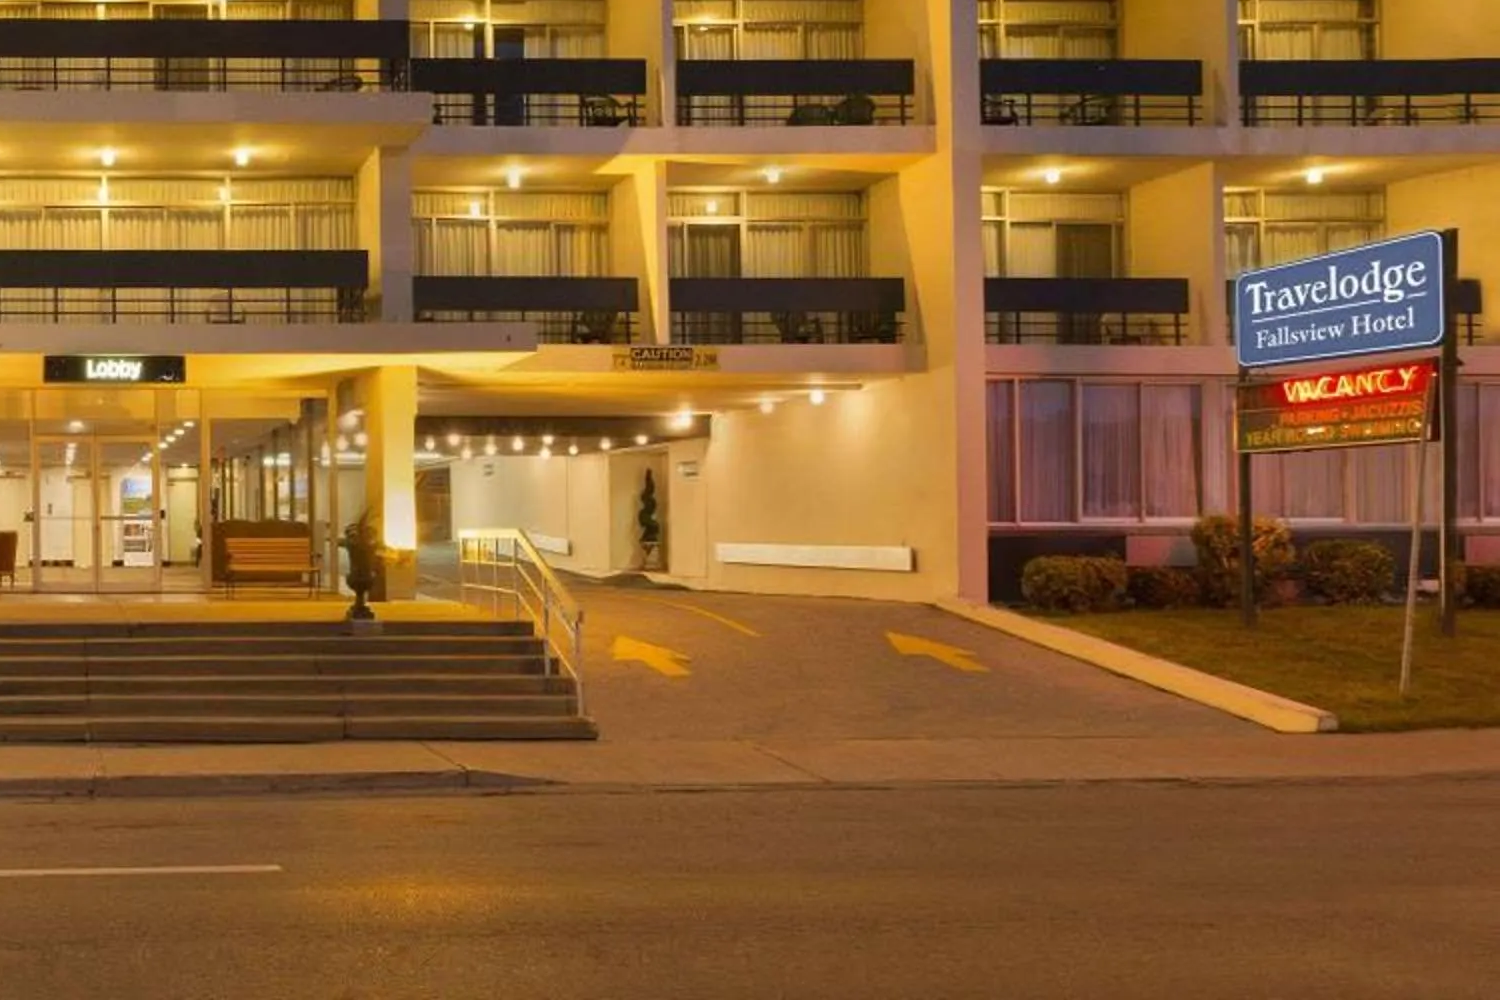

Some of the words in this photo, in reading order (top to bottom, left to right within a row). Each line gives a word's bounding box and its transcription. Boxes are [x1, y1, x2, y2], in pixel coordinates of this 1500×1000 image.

[1245, 259, 1428, 316] Travelodge
[1255, 322, 1345, 350] Fallsview
[1351, 306, 1415, 336] Hotel
[85, 359, 142, 380] Lobby
[631, 349, 692, 360] CAUTION
[1283, 365, 1419, 403] VACANCY
